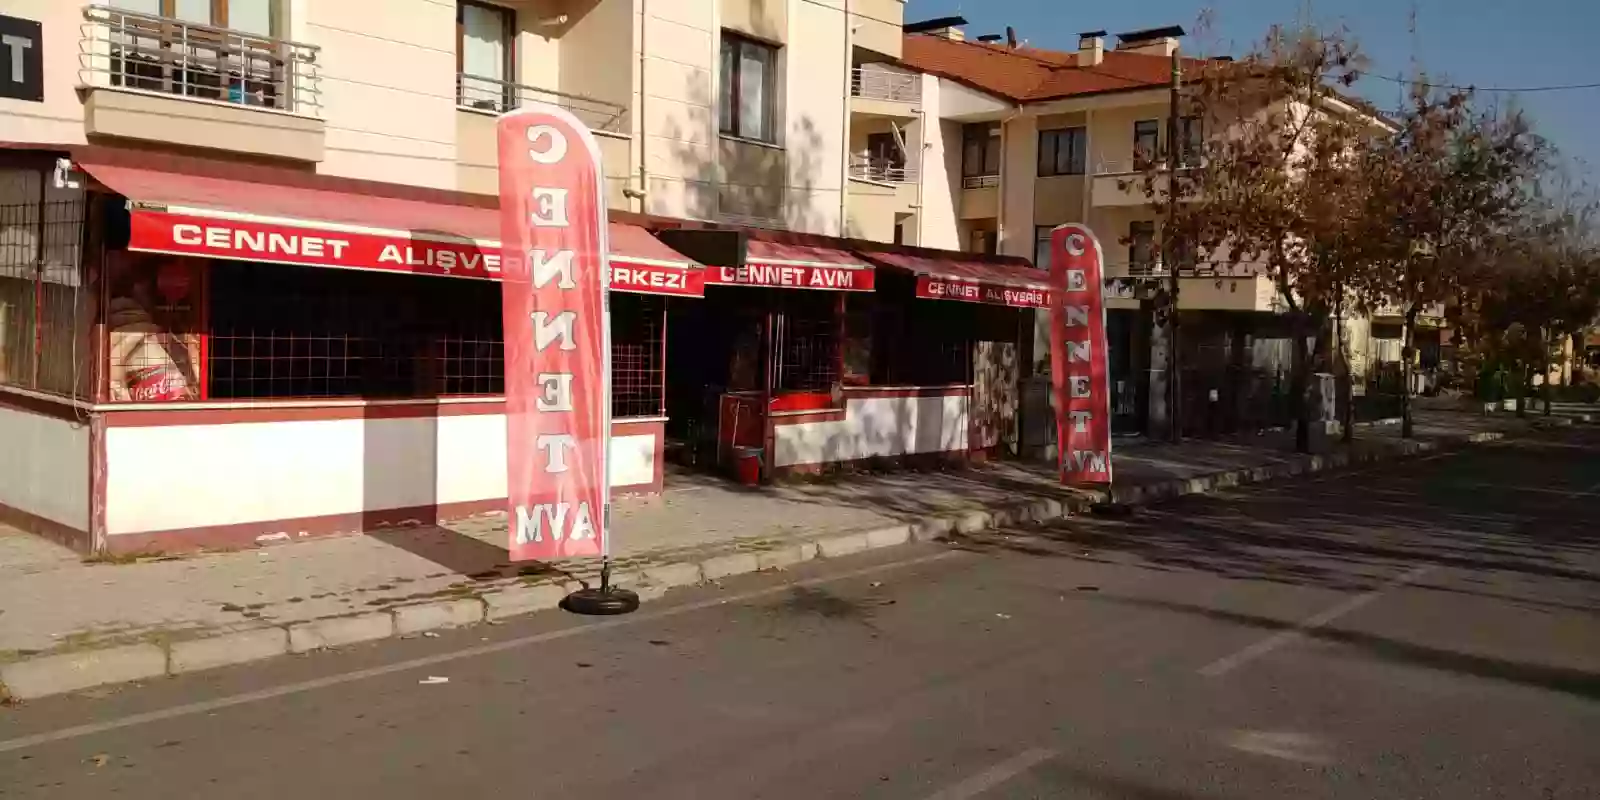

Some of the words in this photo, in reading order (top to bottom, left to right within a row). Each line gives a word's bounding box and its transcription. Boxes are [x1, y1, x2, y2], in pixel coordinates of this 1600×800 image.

[172, 223, 349, 259] CENNET
[720, 264, 805, 286] CENNET
[809, 269, 853, 288] AVM
[928, 281, 980, 298] CENNET
[1065, 233, 1092, 433] CENNET
[1061, 450, 1107, 473] AVM
